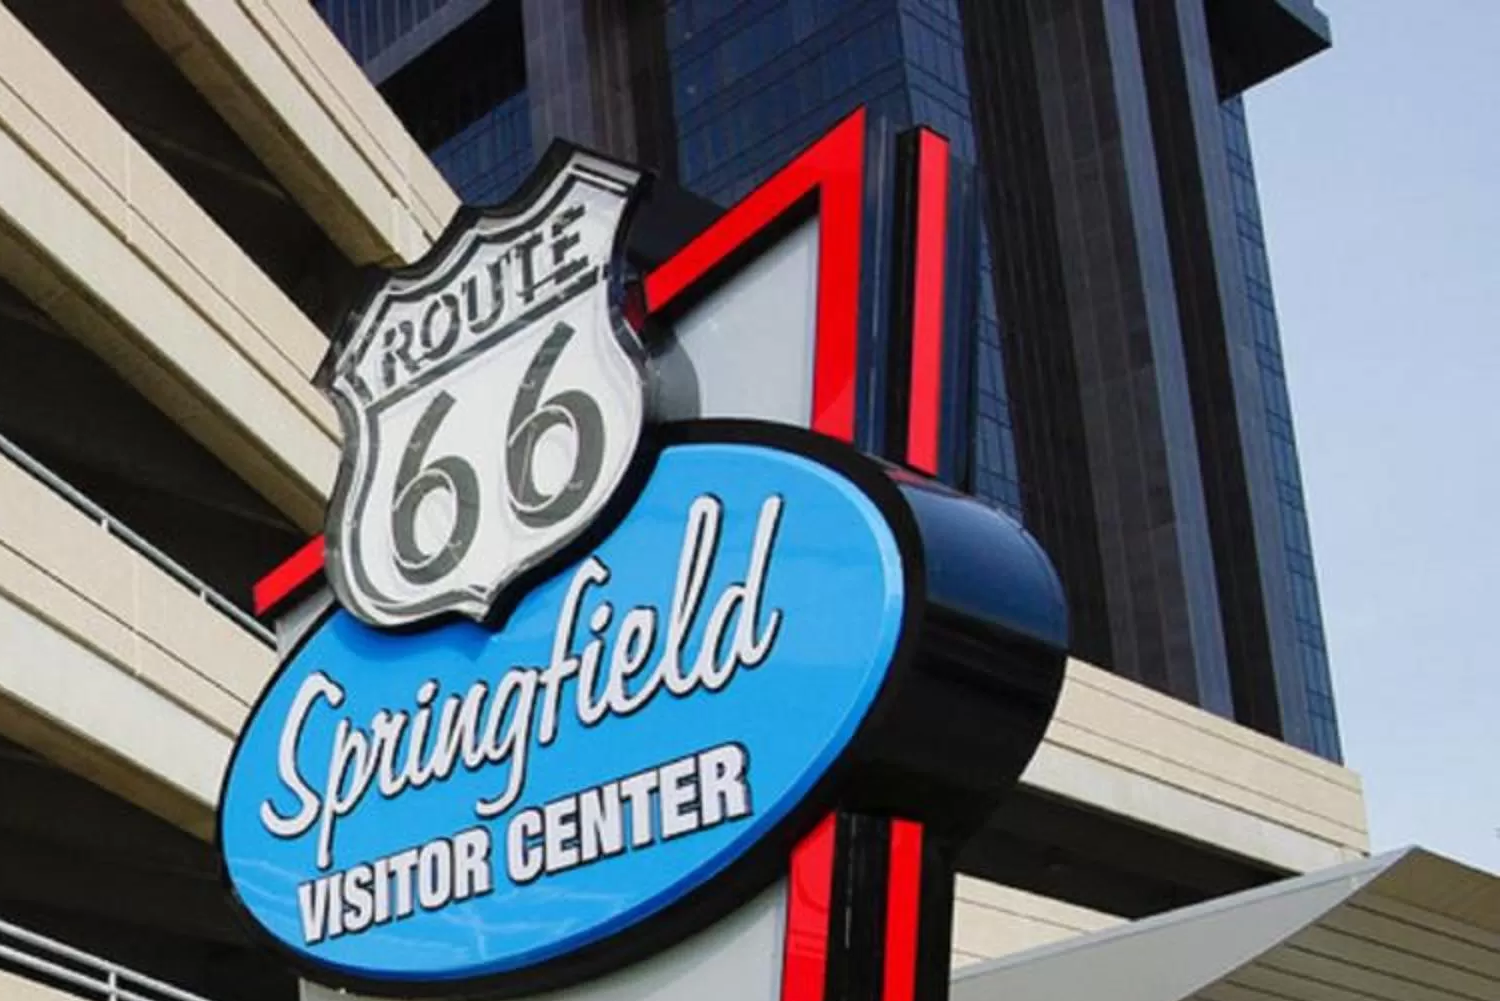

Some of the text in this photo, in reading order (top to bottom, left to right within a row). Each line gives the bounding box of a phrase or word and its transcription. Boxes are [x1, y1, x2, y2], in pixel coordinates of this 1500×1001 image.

[380, 204, 590, 388] ROUTE
[391, 320, 606, 586] 66
[259, 493, 785, 870] Springfield
[297, 742, 753, 944] VISITOR CENTER
